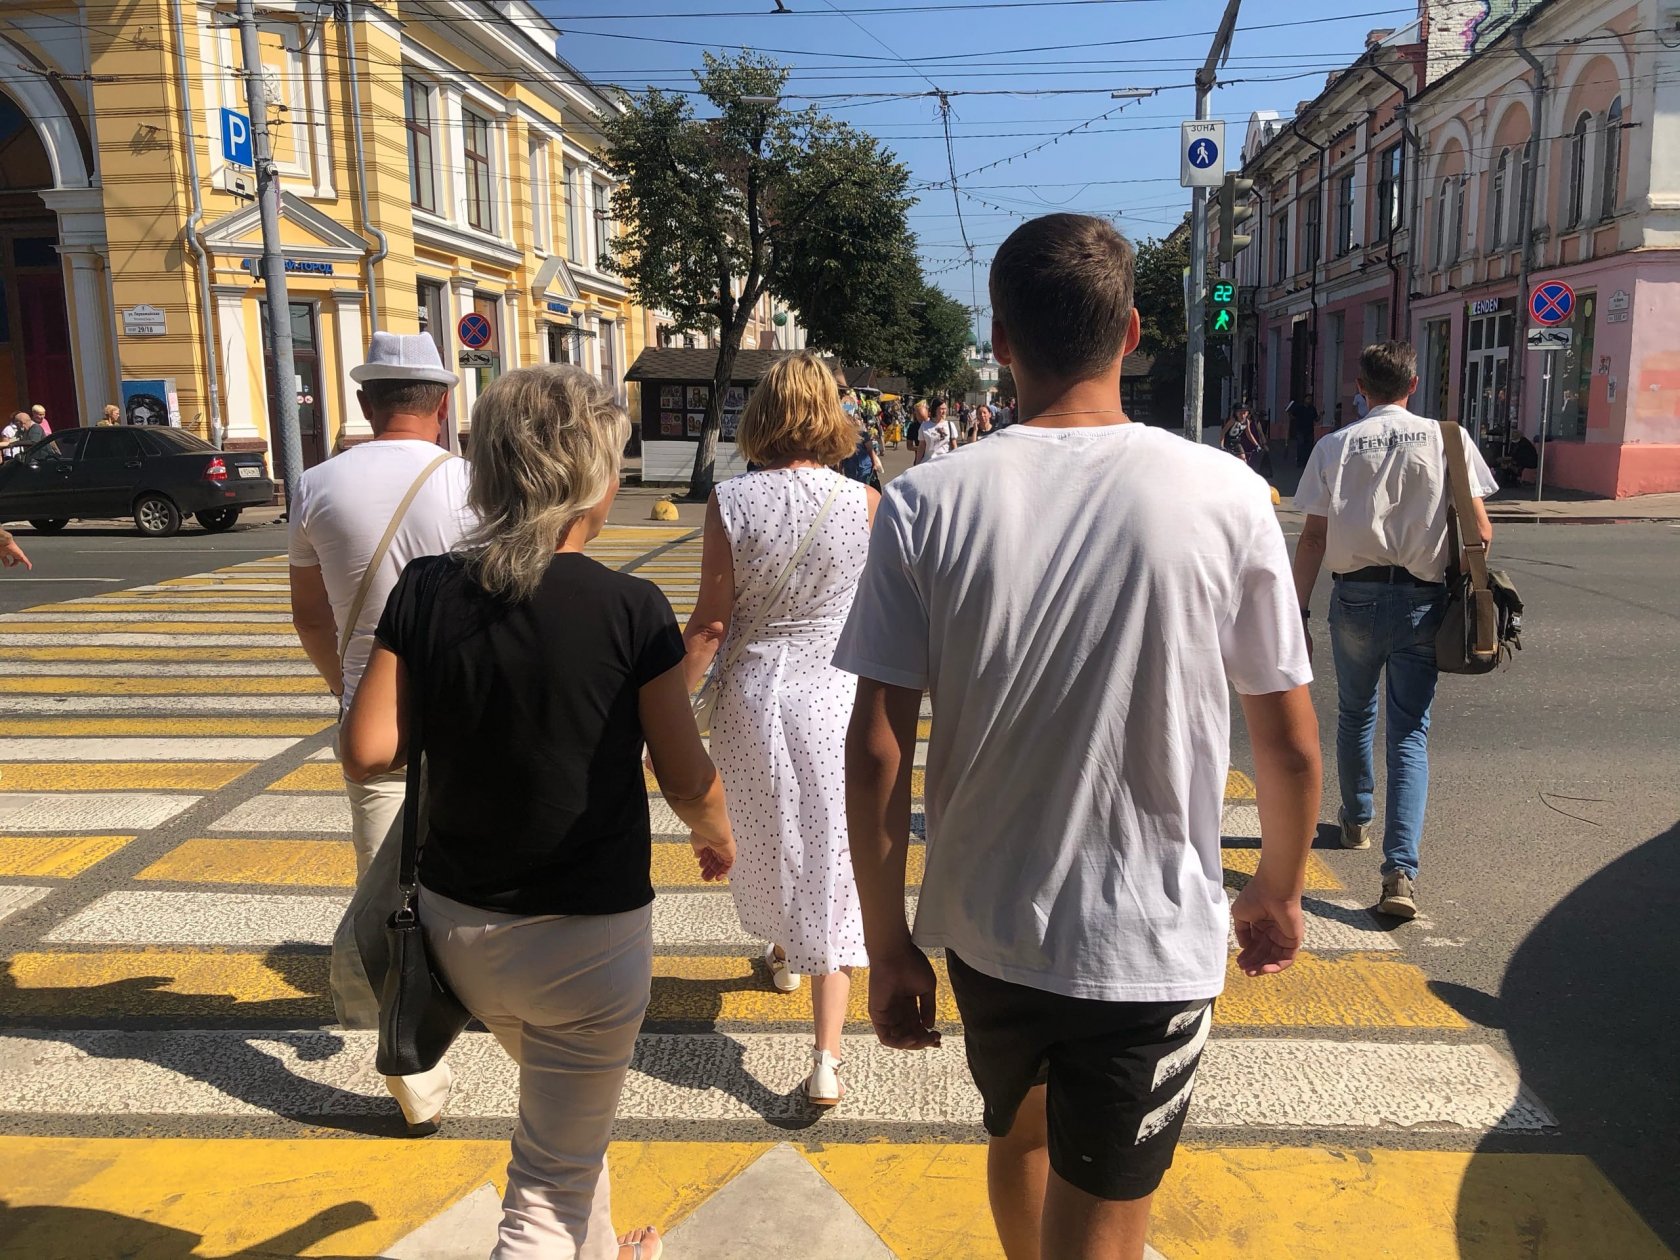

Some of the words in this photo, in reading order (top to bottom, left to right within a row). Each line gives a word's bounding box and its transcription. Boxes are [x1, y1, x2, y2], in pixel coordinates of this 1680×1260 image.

[228, 114, 246, 156] P
[1191, 124, 1215, 132] ЗОНА
[1214, 285, 1232, 301] 22
[1472, 298, 1499, 315] ZENDEN
[1358, 431, 1427, 450] FENCING
